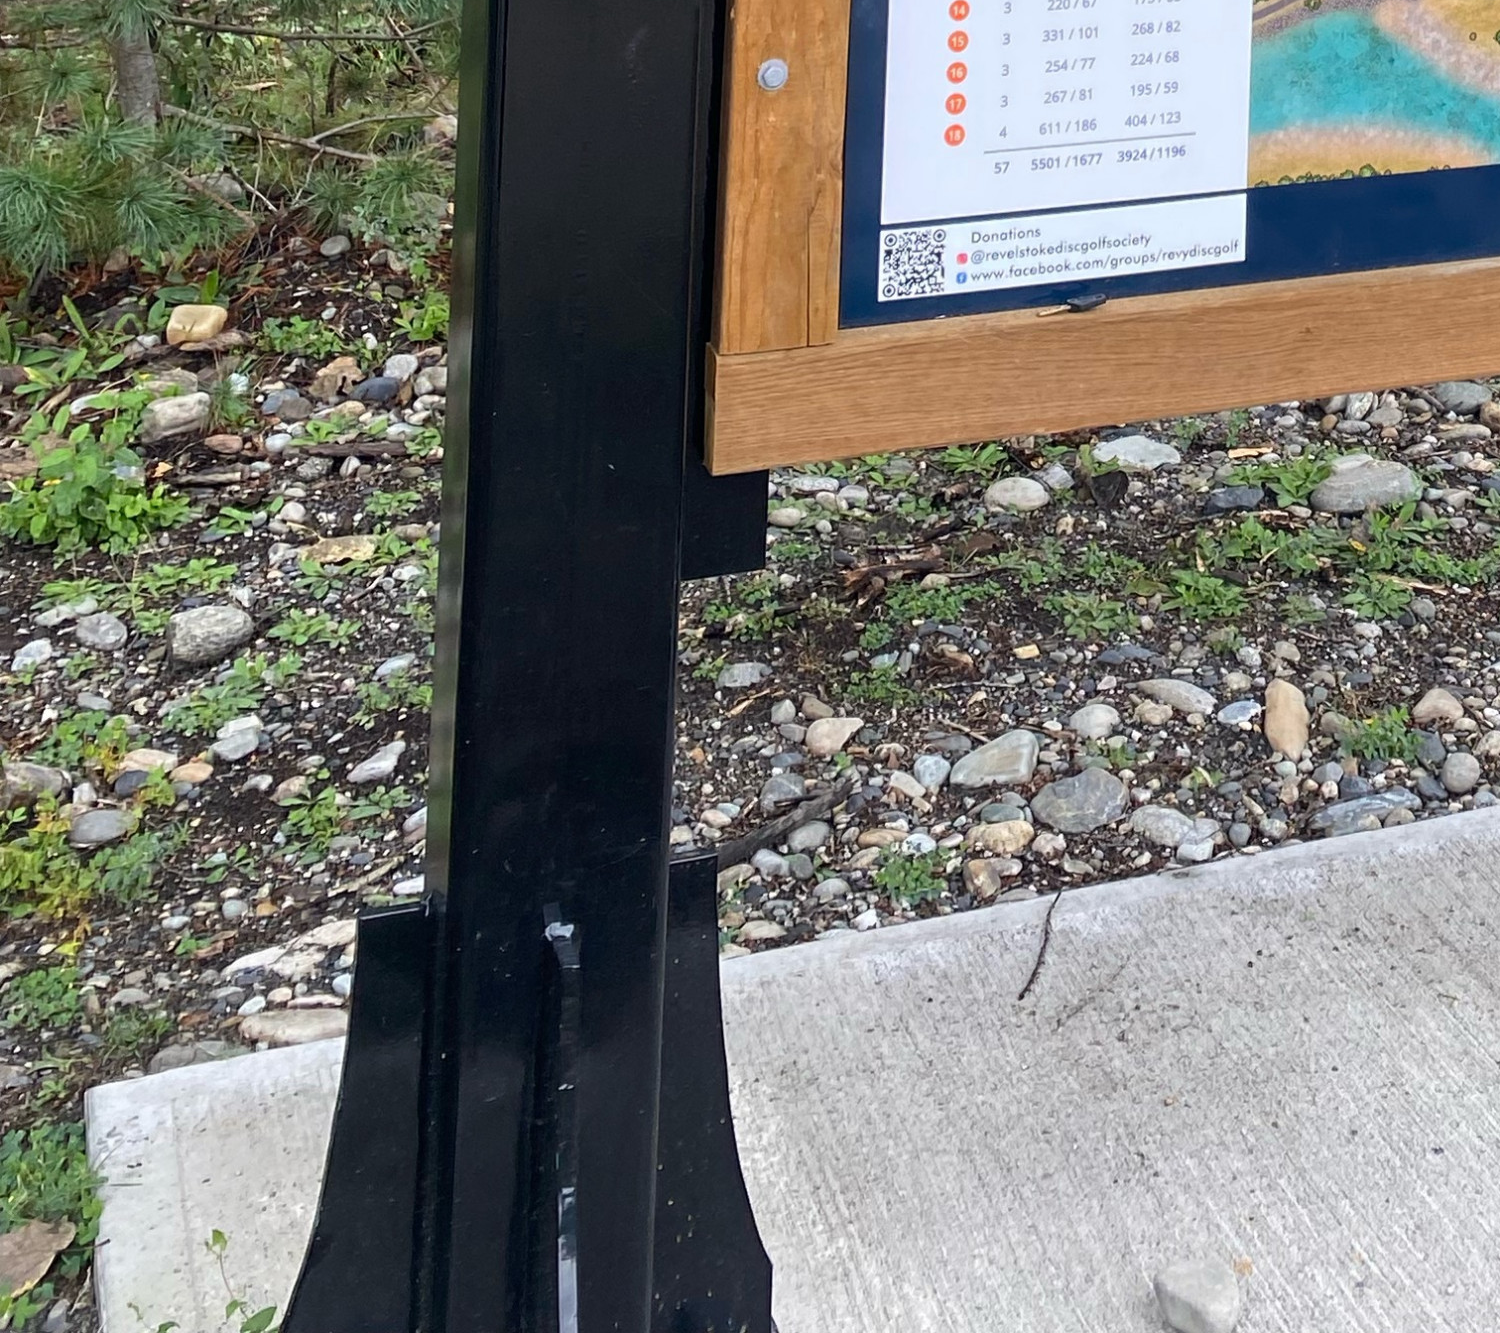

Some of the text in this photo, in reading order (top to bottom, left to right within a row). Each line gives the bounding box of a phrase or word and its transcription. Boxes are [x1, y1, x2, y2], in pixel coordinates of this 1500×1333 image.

[998, 125, 1007, 137] 4
[993, 160, 1010, 174] 57
[971, 229, 1041, 245] Donations
[970, 236, 1151, 263] @revelstokediscgolfsociety
[970, 241, 1238, 280] www.facebook.com/groups/revydiscgolf
